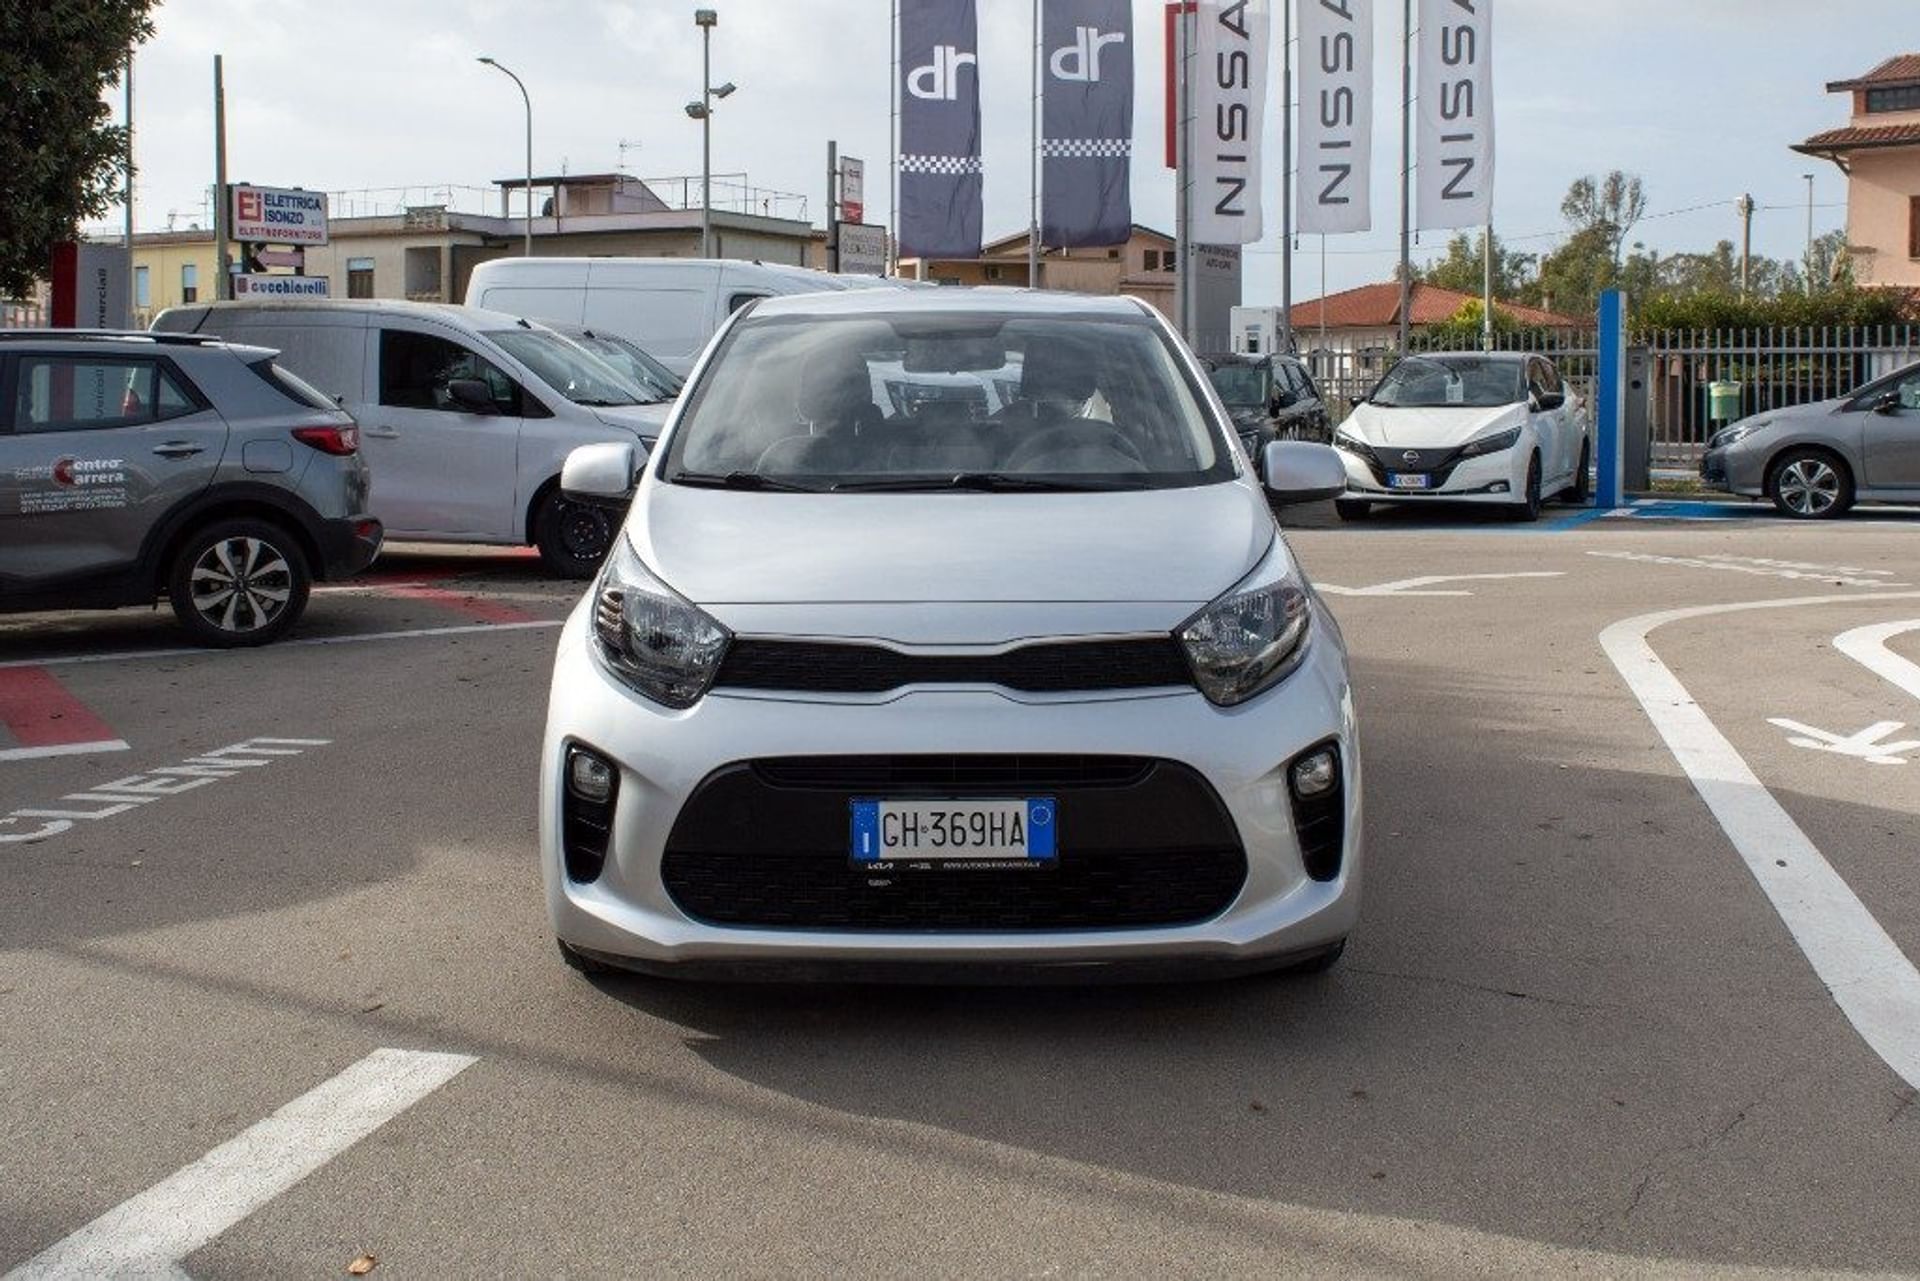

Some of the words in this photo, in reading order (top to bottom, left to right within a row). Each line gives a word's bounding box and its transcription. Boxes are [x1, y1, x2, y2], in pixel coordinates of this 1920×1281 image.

[1050, 26, 1125, 82] dr
[907, 45, 976, 100] dr
[264, 193, 322, 211] ELETTRICA
[264, 209, 305, 224] ISONZO
